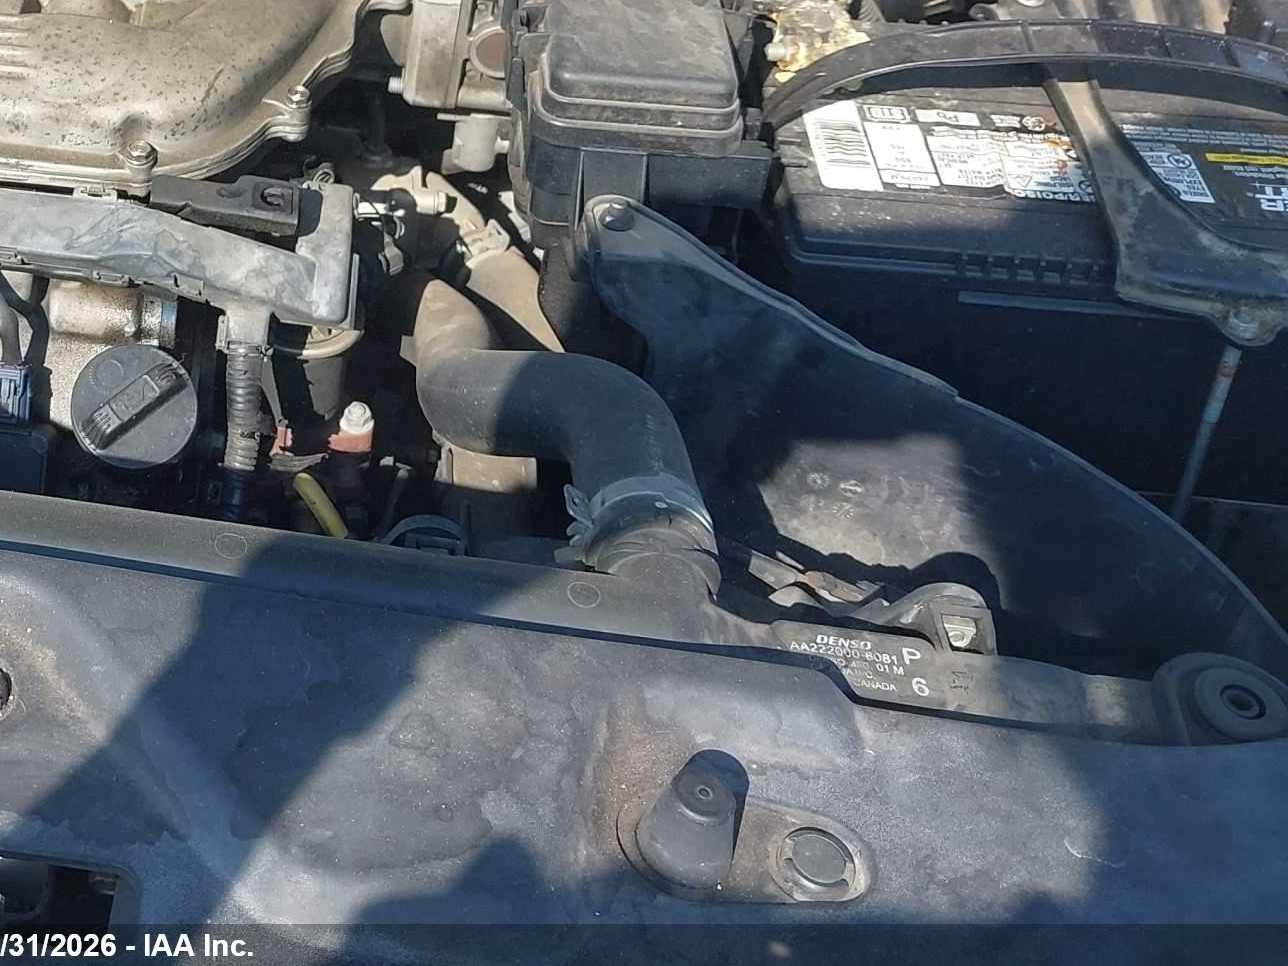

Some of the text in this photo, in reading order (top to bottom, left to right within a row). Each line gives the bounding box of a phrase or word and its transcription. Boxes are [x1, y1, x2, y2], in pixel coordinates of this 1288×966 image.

[816, 634, 872, 651] DENSO
[902, 647, 921, 666] P
[853, 679, 897, 692] CANADA
[912, 677, 929, 696] 6
